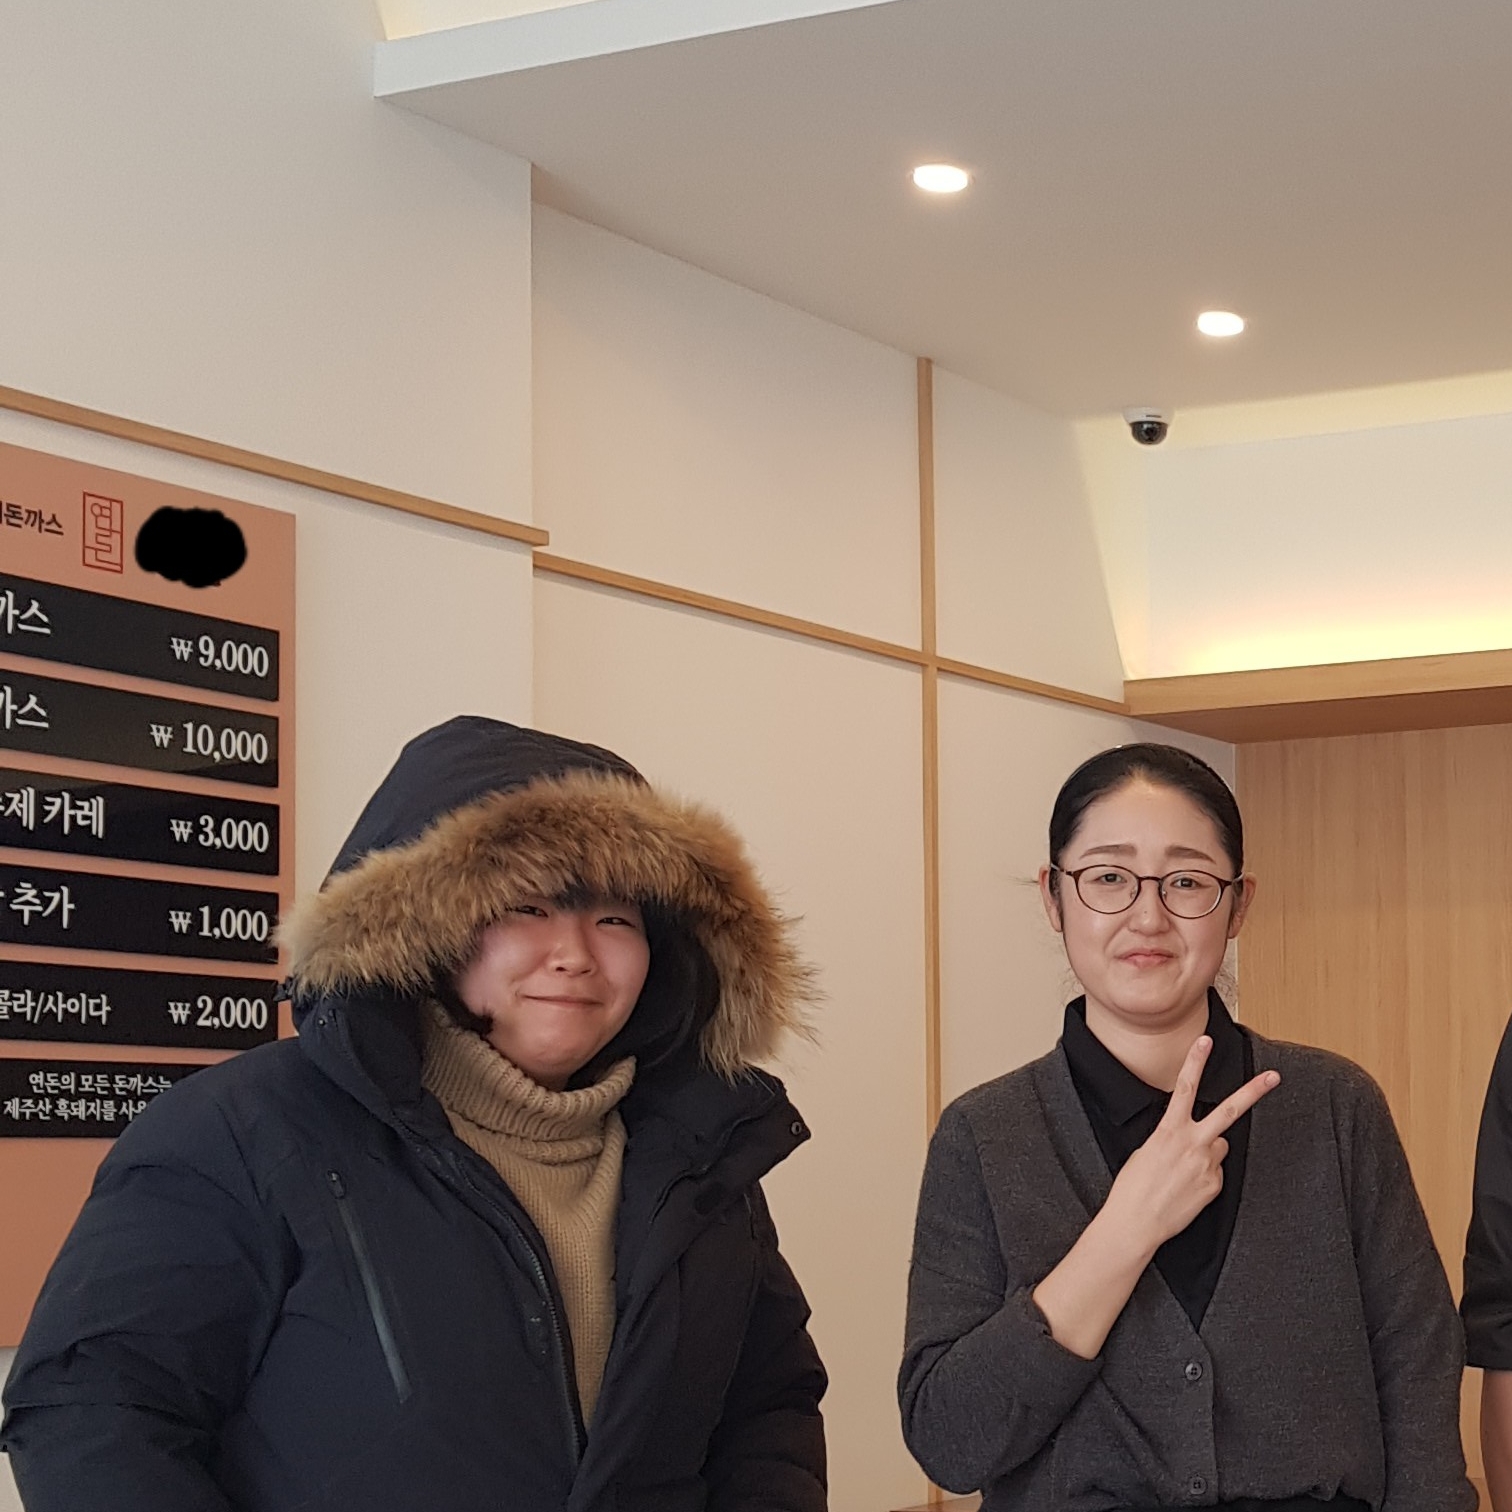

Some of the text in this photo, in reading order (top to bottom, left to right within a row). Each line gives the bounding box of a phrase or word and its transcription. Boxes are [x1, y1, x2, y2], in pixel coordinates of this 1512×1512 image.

[0, 500, 64, 536] 돈까스
[0, 786, 35, 831] 제
[43, 791, 105, 839] 카레
[9, 881, 75, 930] 추가
[29, 1071, 75, 1095] 연돈의
[78, 1073, 111, 1096] 모든
[3, 1096, 52, 1121] 제주산
[54, 1097, 117, 1122] 흑돼지를
